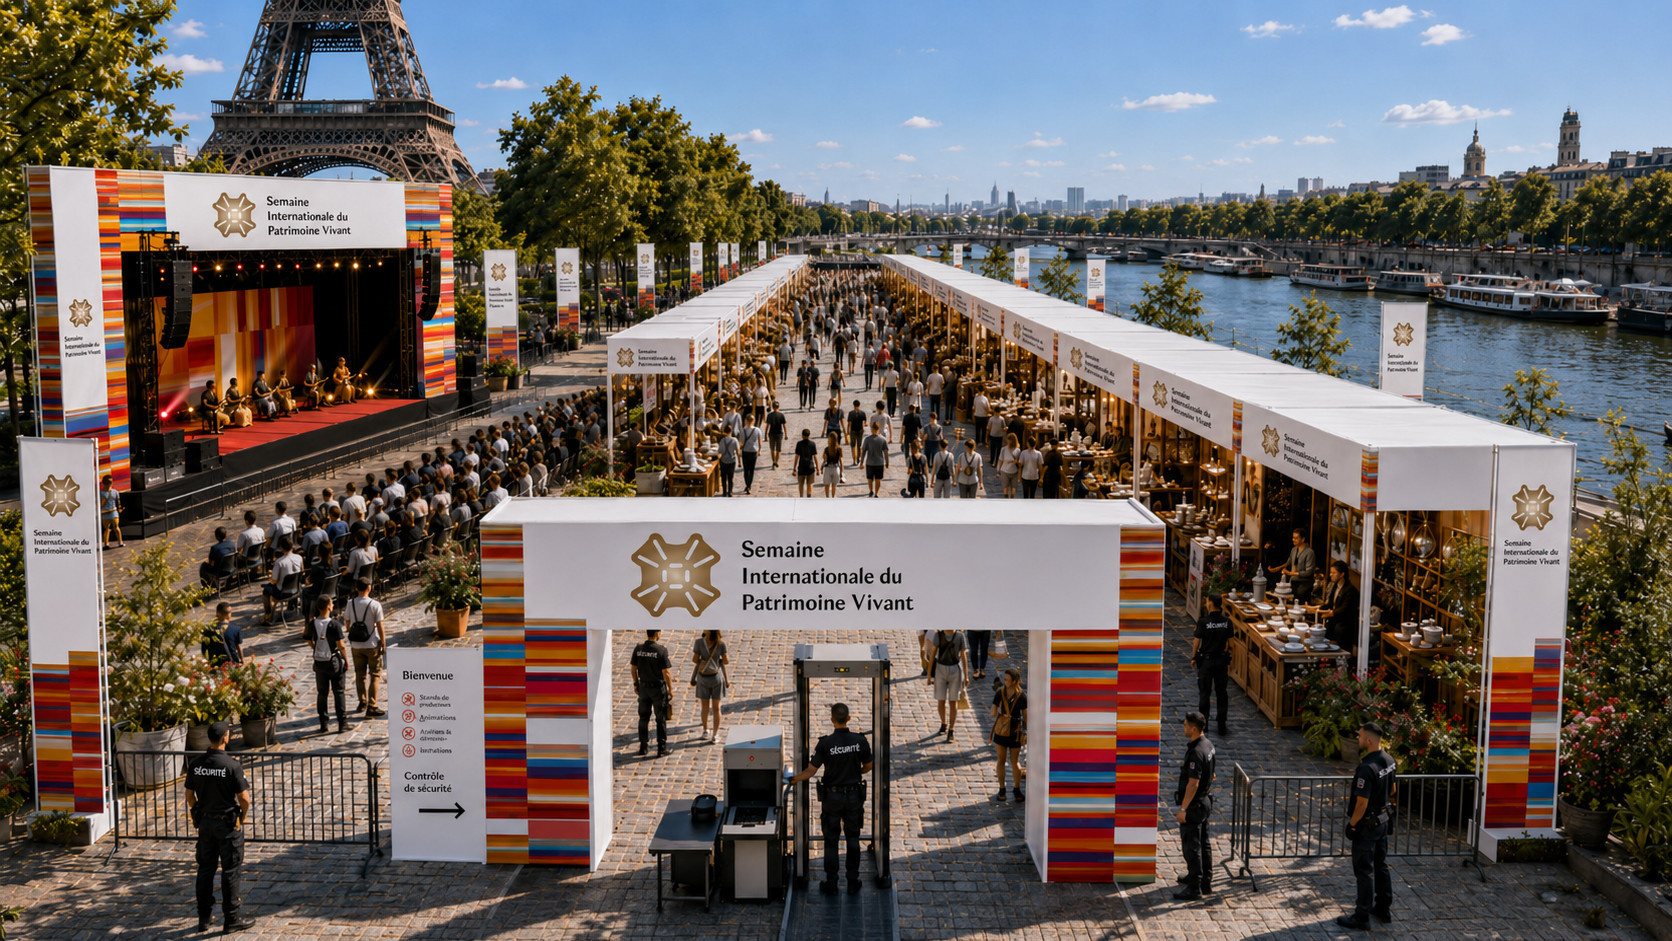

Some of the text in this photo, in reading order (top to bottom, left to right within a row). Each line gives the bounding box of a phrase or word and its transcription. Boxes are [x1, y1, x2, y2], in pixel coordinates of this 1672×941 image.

[266, 195, 310, 207] Semaine
[267, 211, 348, 221] Internationale du
[268, 225, 351, 236] Patrimoine Vivant
[1284, 433, 1305, 448] Semaine
[741, 540, 825, 558] Semaine
[1503, 548, 1549, 556] Internationale
[742, 567, 902, 584] Internationale du
[742, 594, 914, 611] Patrimoine Vivant
[402, 670, 454, 681] Bienvenue
[419, 714, 456, 722] Animations
[404, 771, 445, 781] Contrôle
[404, 783, 452, 793] de sécurité
